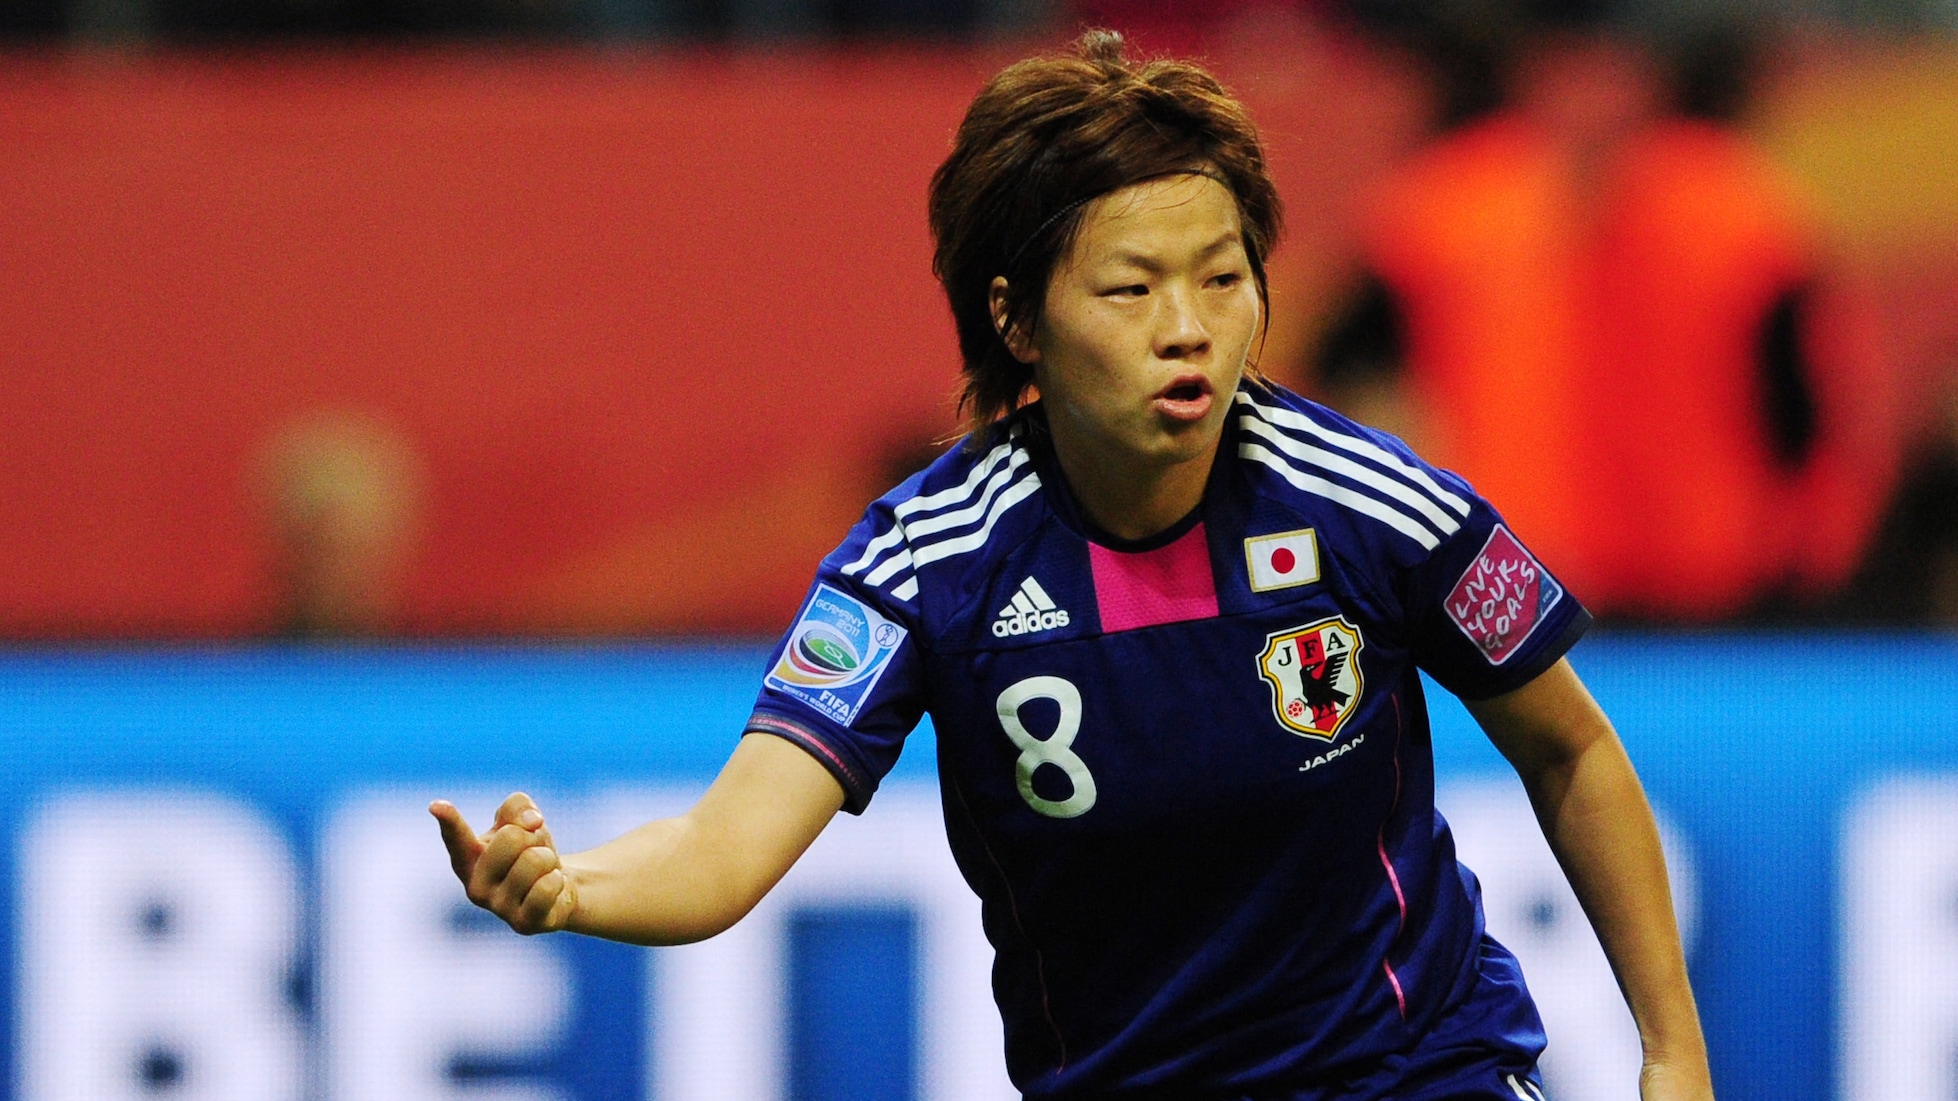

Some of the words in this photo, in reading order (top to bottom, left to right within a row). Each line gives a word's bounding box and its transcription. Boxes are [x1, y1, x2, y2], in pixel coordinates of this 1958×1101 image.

[1455, 554, 1495, 619] LIVE
[1466, 559, 1518, 633] YOUR
[1484, 560, 1535, 649] GOALS
[815, 598, 866, 628] GERMANY
[835, 618, 861, 637] 2011
[992, 609, 1070, 637] adidas
[1278, 631, 1346, 667] JFA
[809, 697, 832, 714] WORLD
[832, 711, 846, 722] CUP
[819, 689, 850, 717] FIFA
[996, 675, 1097, 818] 8
[1299, 733, 1365, 772] JAPAN
